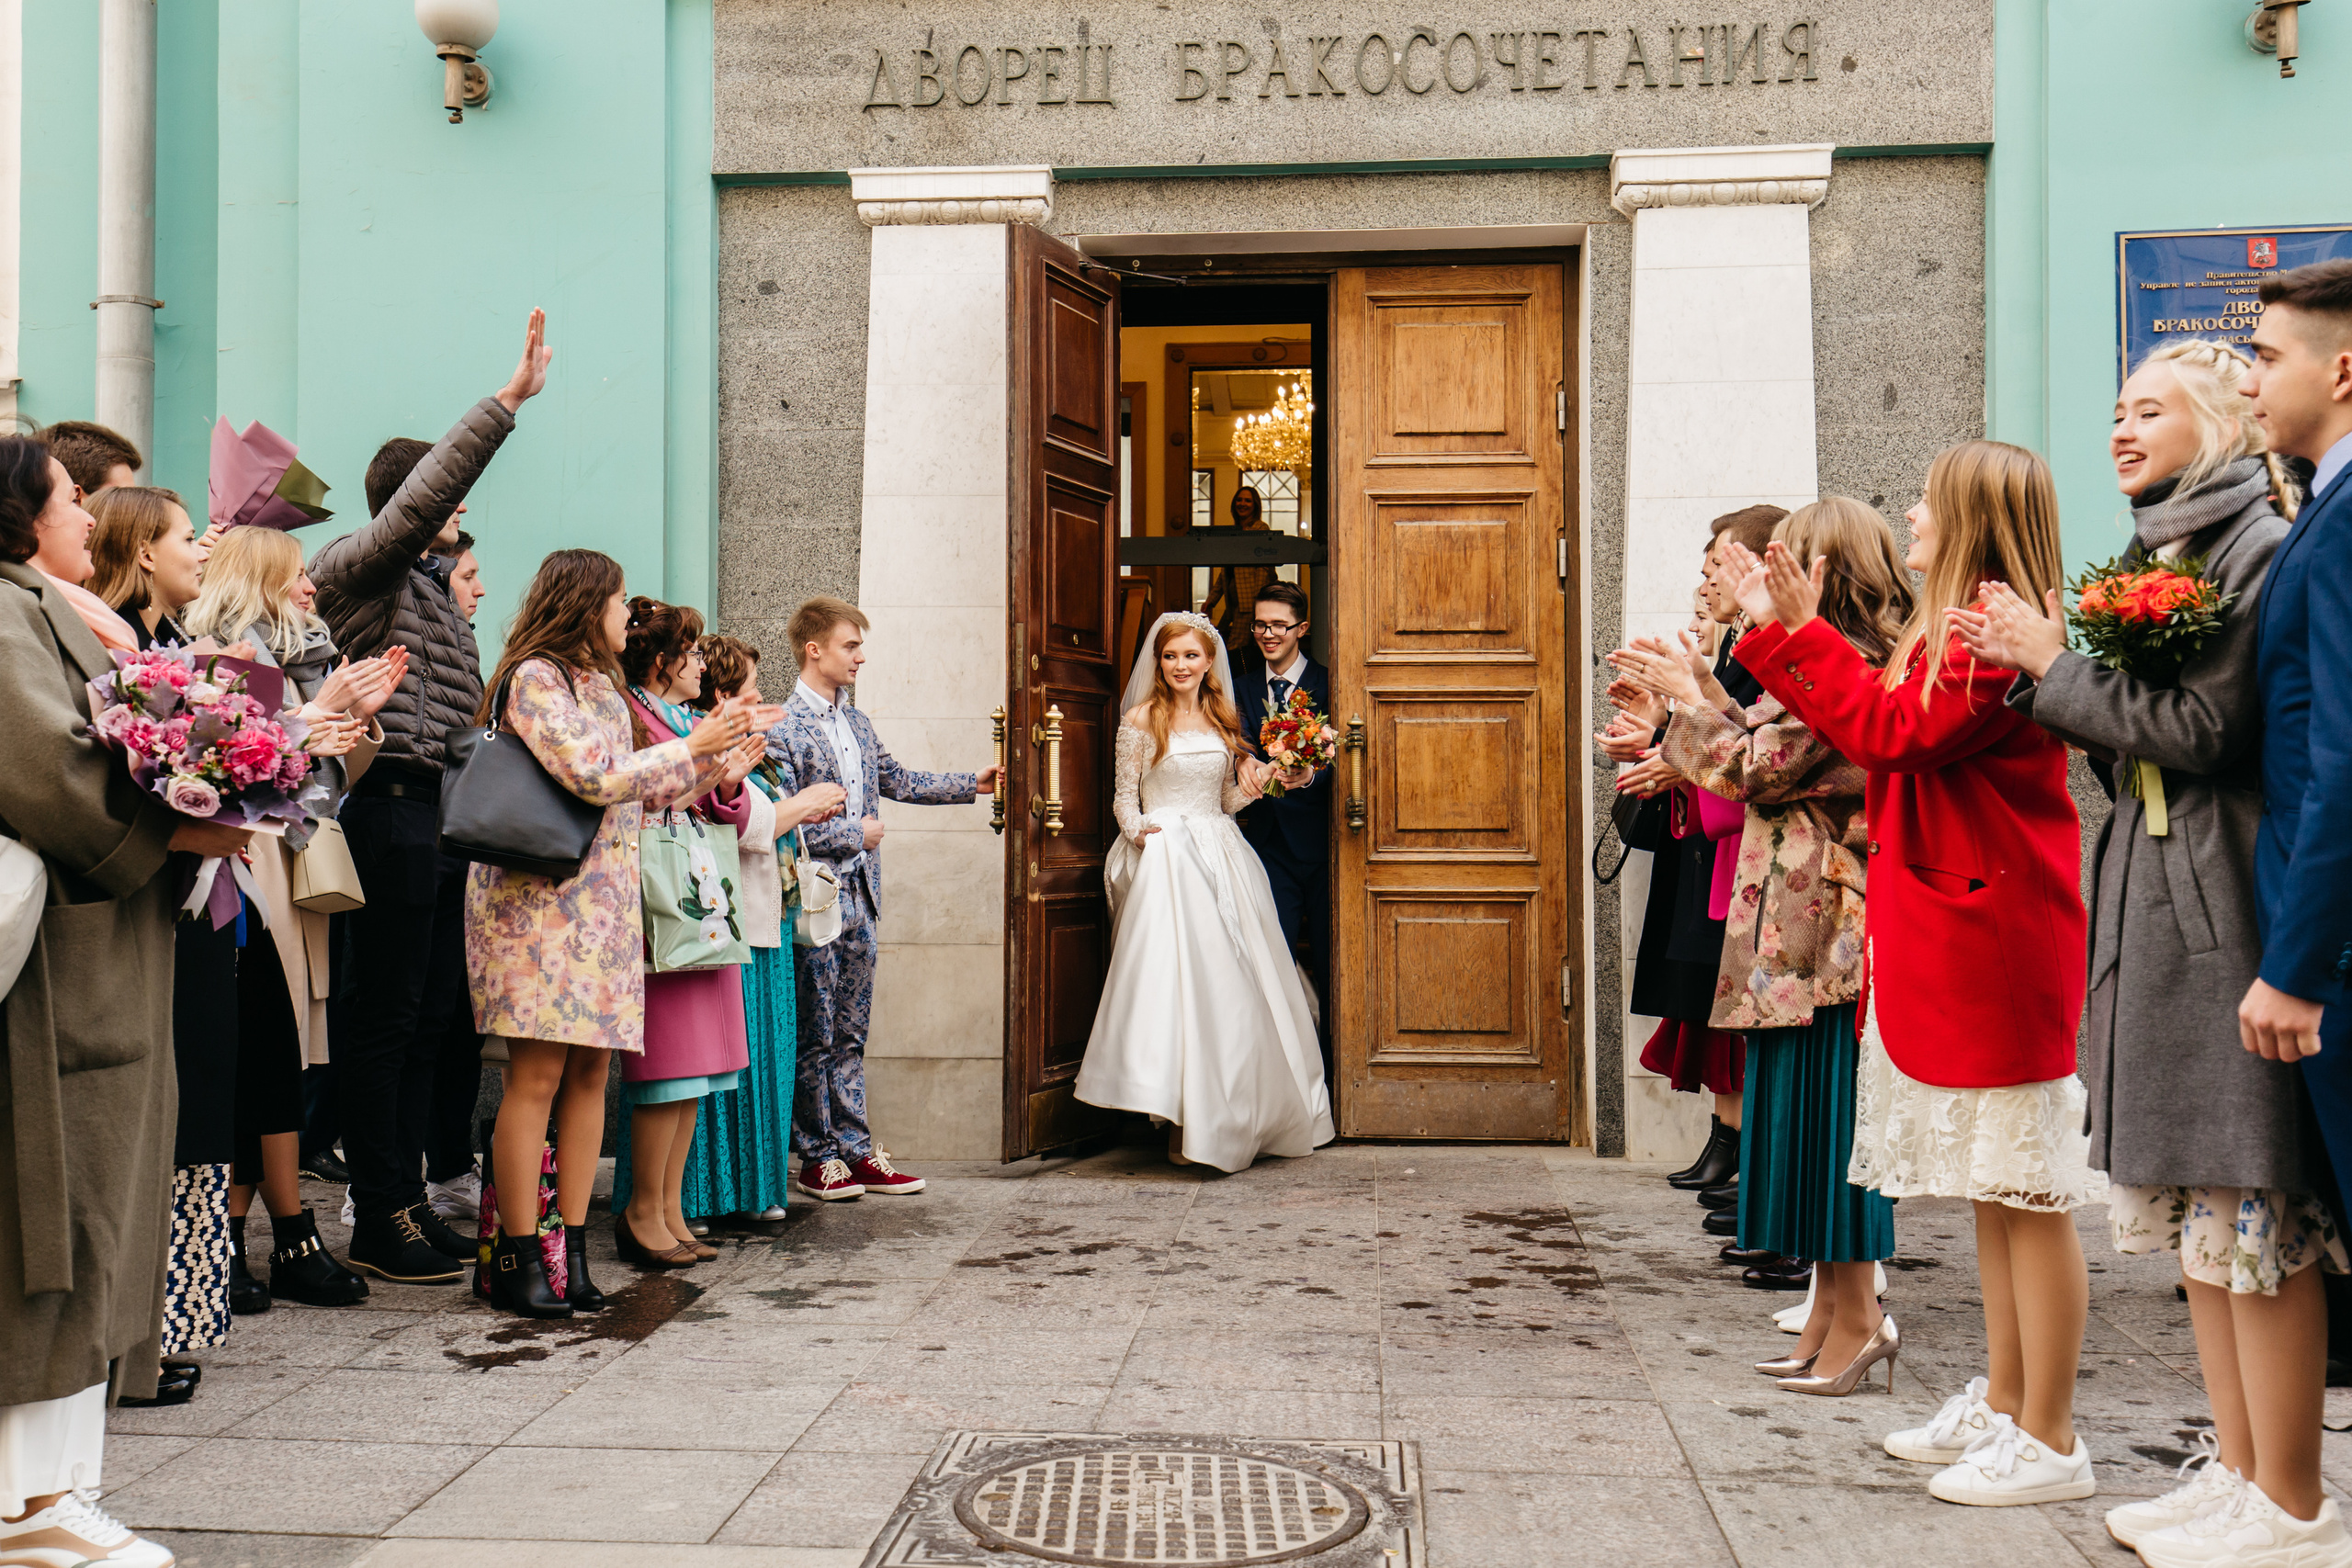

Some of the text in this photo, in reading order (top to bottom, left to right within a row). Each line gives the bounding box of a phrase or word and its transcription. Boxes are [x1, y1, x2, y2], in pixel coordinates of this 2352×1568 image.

[862, 19, 1818, 112] ДВОРЕЦ БРАКОСОЧЕТАНИЯ
[2206, 269, 2278, 280] Правительство
[2225, 288, 2259, 296] города
[2222, 300, 2267, 317] ДВО
[2153, 316, 2262, 333] БРАКОСОЧ
